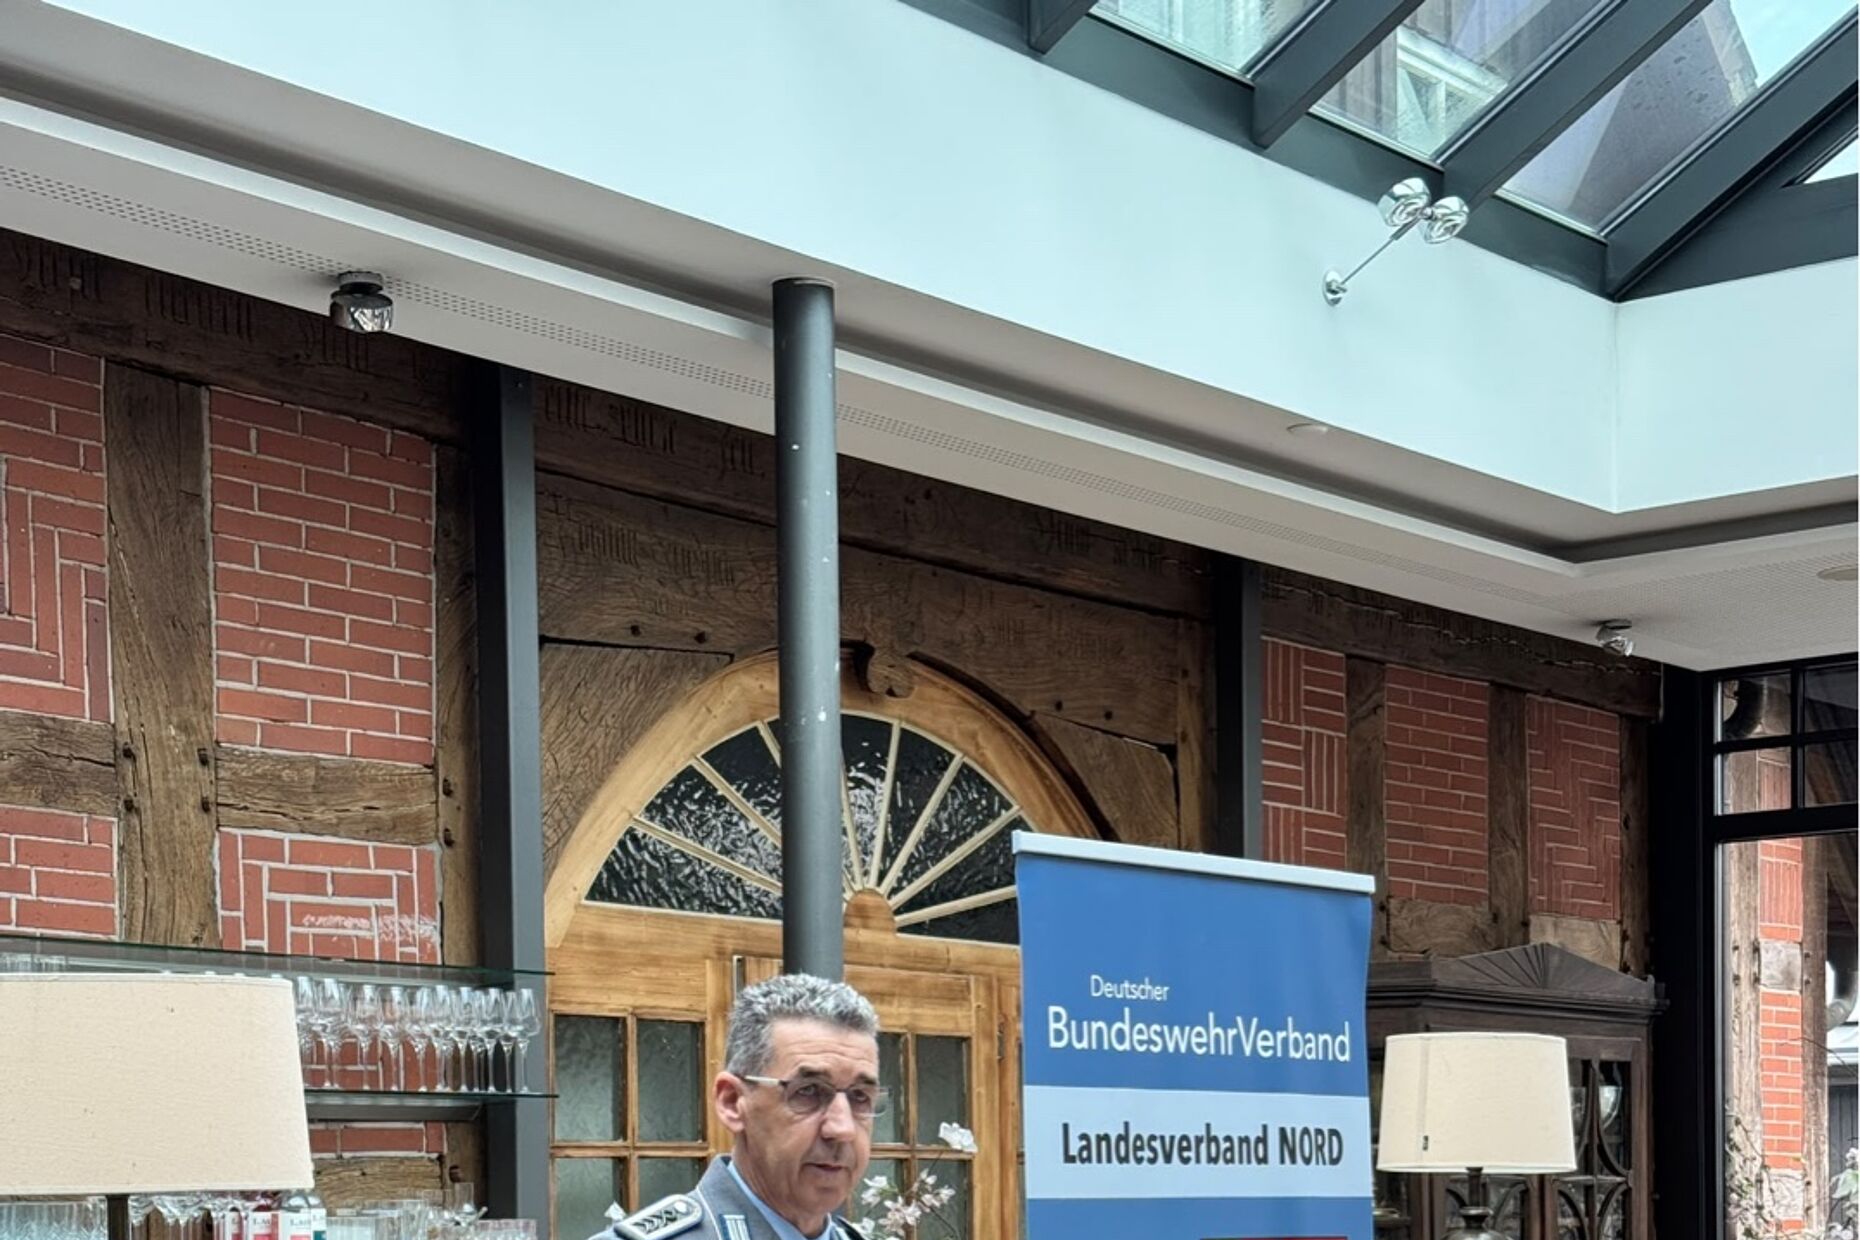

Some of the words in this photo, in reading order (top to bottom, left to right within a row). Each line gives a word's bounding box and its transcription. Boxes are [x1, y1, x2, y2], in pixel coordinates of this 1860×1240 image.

[1090, 974, 1169, 1001] Deutscher
[1048, 1005, 1350, 1062] BundeswehrVerband
[1062, 1121, 1269, 1166] Landesverband
[1279, 1126, 1344, 1166] NORD
